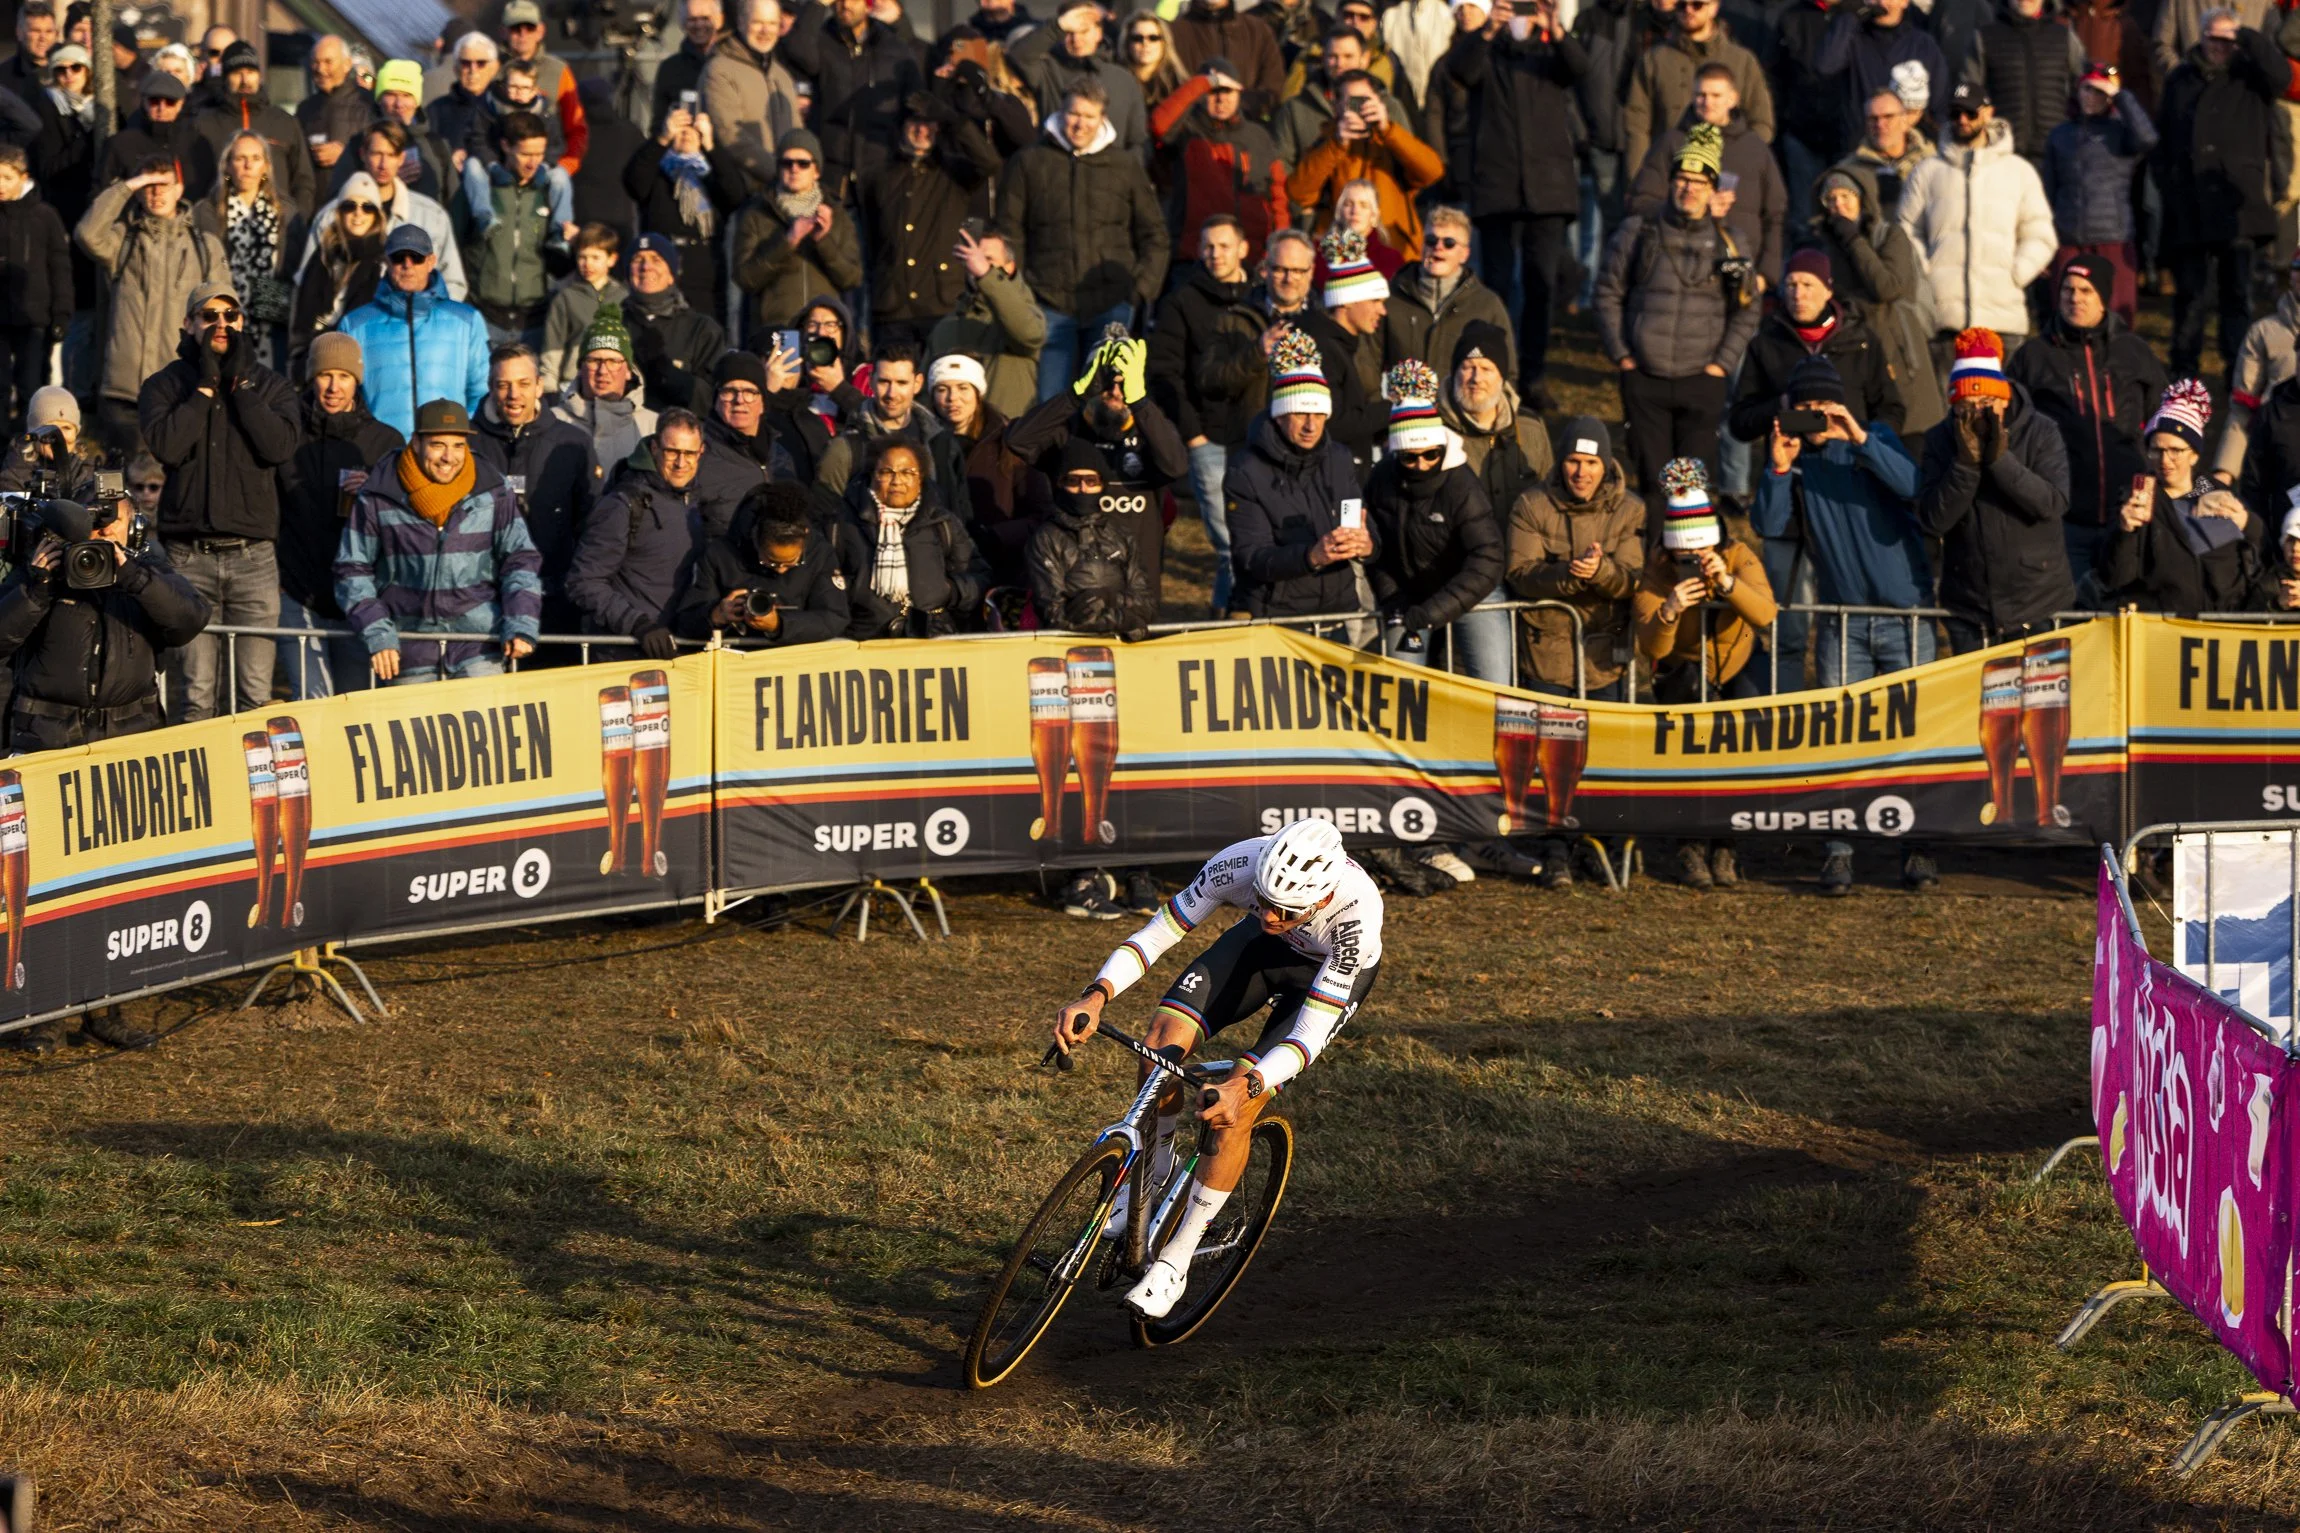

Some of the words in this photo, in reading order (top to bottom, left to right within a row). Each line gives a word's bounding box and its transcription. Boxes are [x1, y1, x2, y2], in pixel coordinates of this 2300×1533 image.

[2180, 636, 2300, 711] FLAN
[754, 667, 970, 751] FLANDRIEN
[1030, 688, 1059, 696] SUPER
[1071, 697, 1103, 705] SUPER
[1178, 656, 1429, 742] FLANDRIEN
[602, 717, 625, 728] SUPER
[633, 722, 660, 734] SUPER
[1654, 679, 1918, 755] FLANDRIEN
[344, 701, 553, 803] FLANDRIEN
[276, 769, 300, 780] SUPER
[58, 747, 212, 857] FLANDRIEN
[1731, 808, 1859, 831] SUPER
[814, 822, 918, 852] SUPER
[408, 865, 507, 904] SUPER
[1207, 856, 1249, 877] PREMIER
[1210, 872, 1234, 888] TECH
[107, 918, 179, 961] SUPER
[1337, 919, 1363, 976] Alpecin
[1133, 1041, 1185, 1077] CANYON
